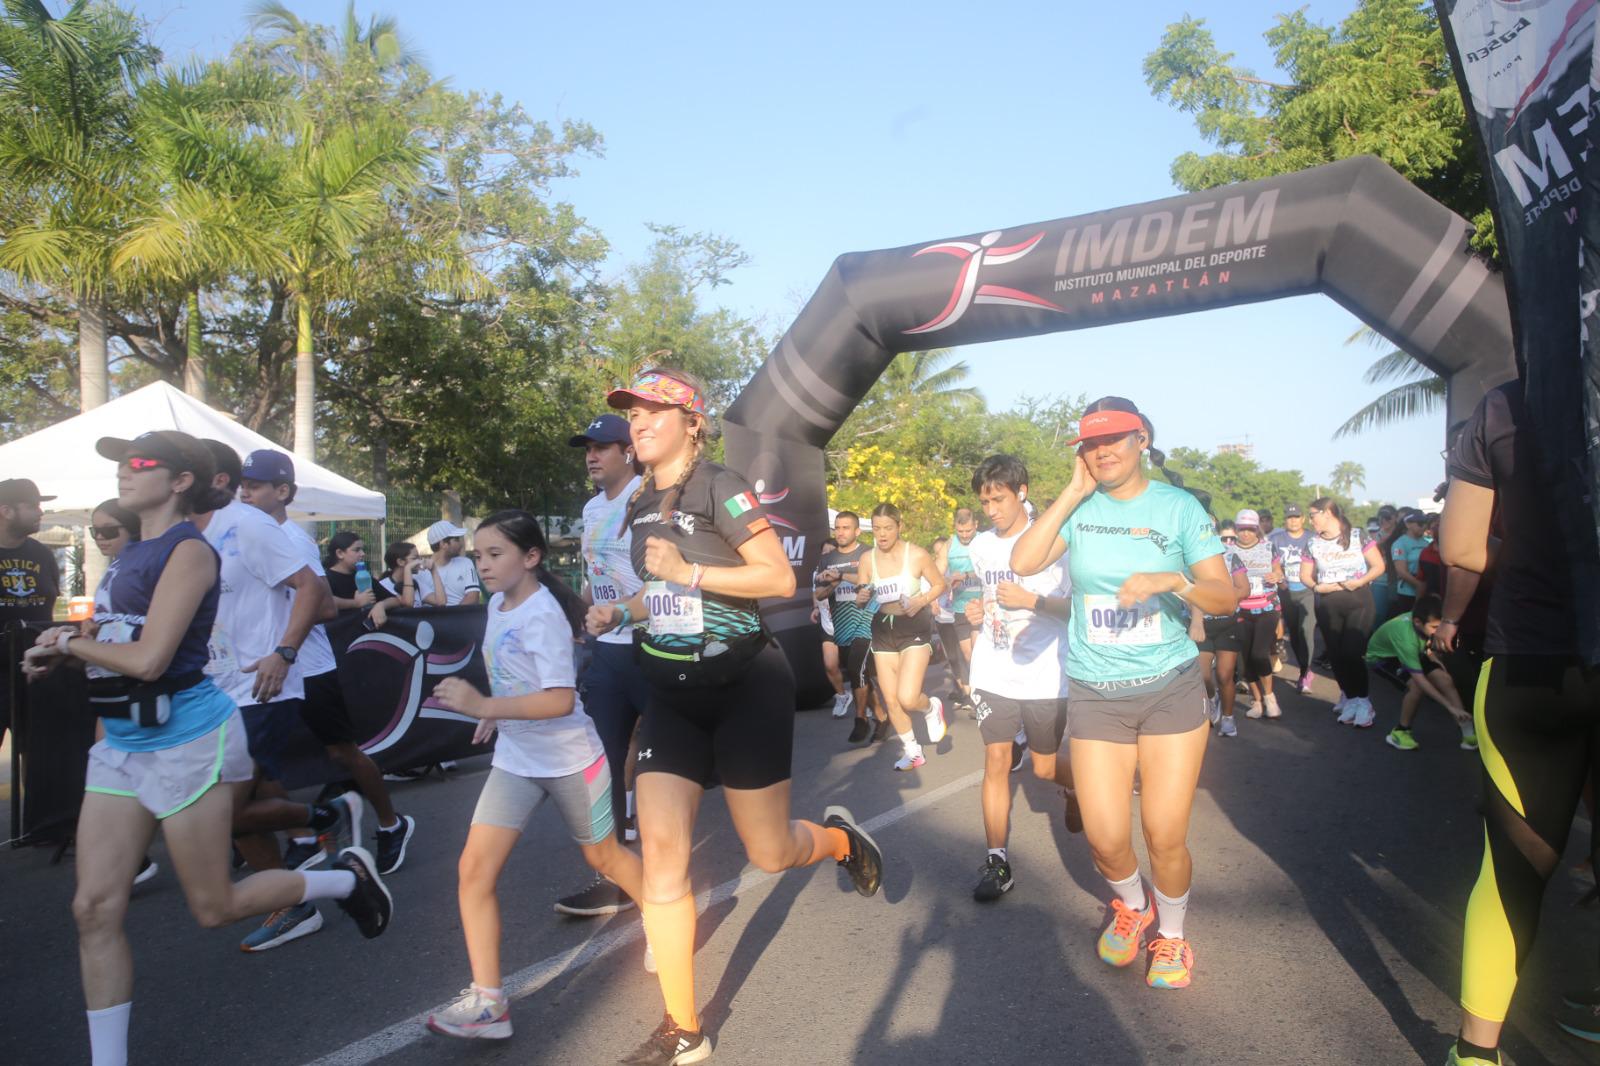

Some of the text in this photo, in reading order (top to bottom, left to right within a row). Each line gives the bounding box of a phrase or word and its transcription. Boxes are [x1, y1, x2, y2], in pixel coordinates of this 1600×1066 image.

[1054, 188, 1281, 277] IMDEM
[1055, 245, 1267, 292] INSTITUTO MUNICIPAL DEL DEPORTE
[1091, 271, 1231, 305] MAZATLÁN
[985, 570, 1015, 585] 0189
[594, 585, 617, 600] 0185
[877, 583, 898, 596] 0017
[1091, 608, 1139, 628] 0027
